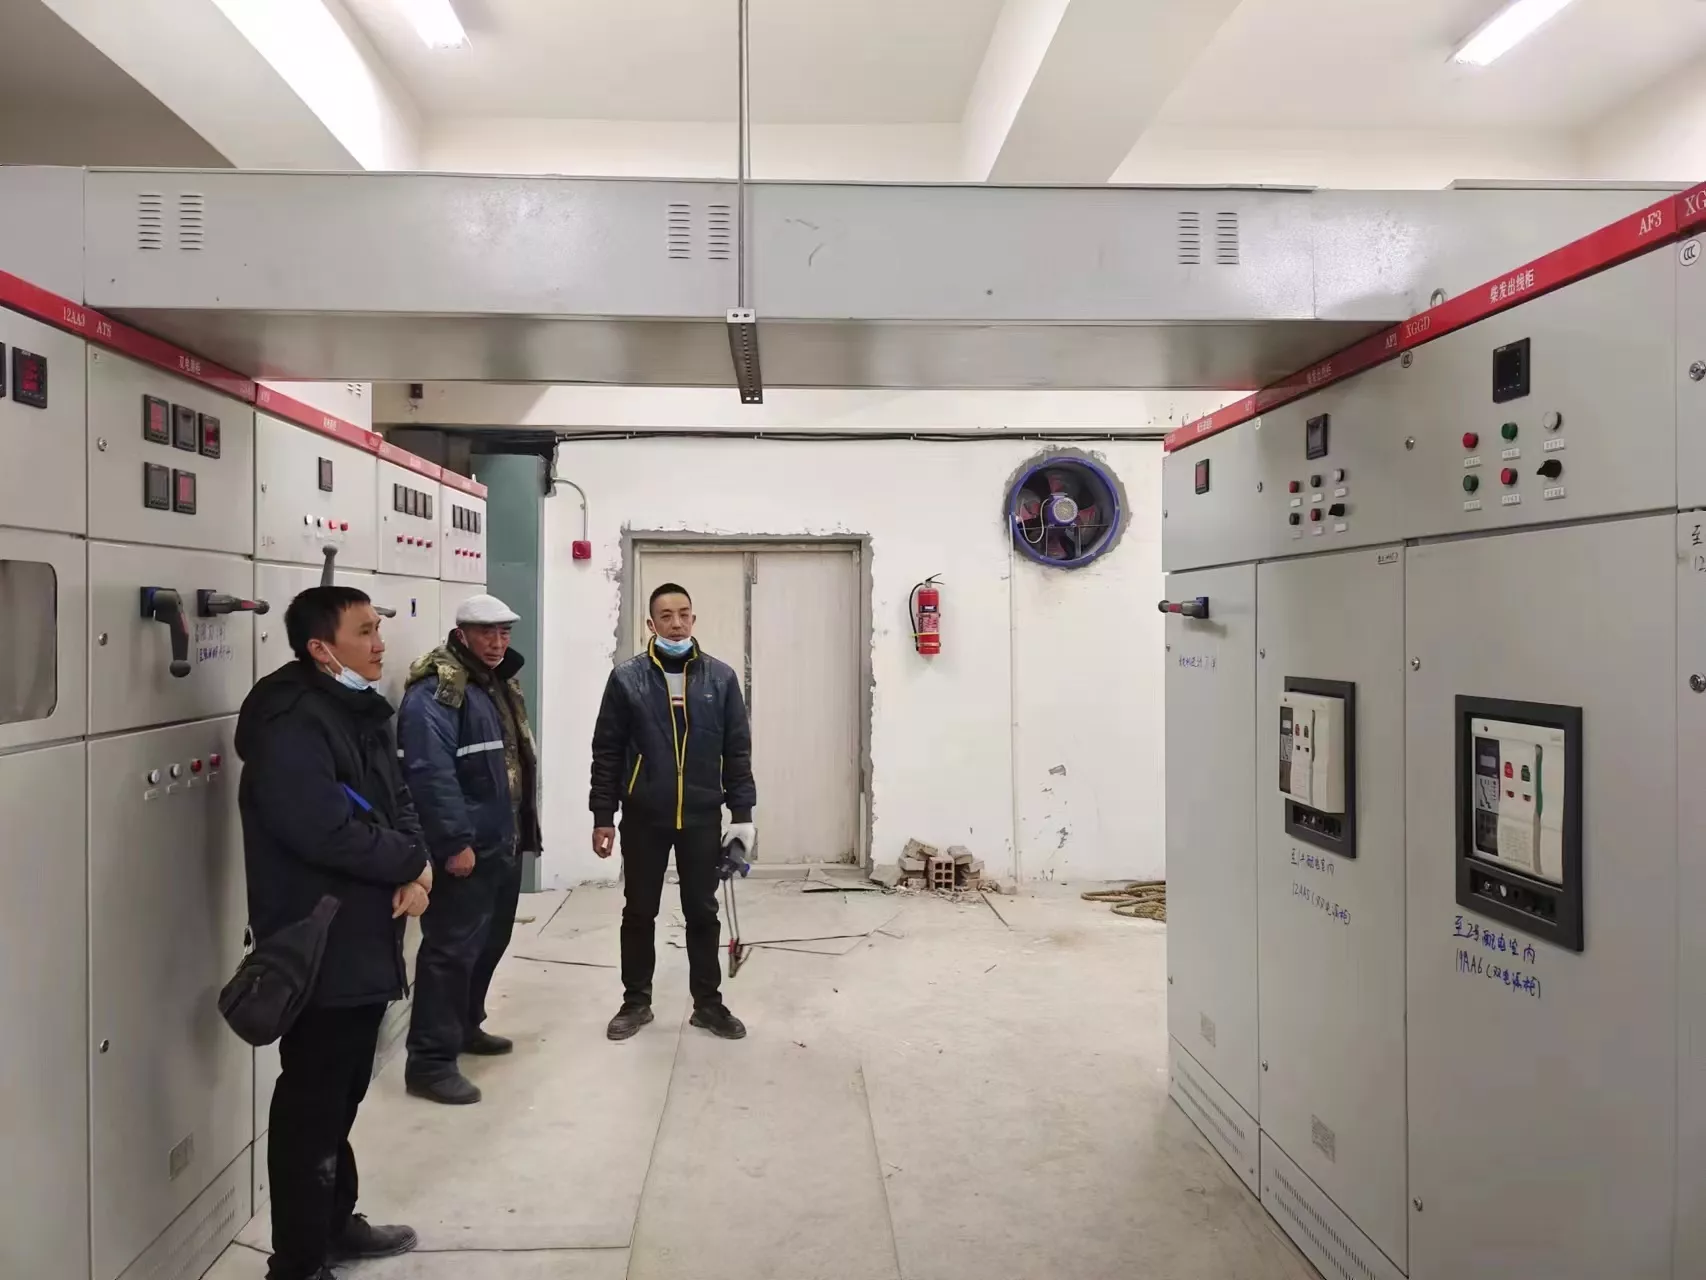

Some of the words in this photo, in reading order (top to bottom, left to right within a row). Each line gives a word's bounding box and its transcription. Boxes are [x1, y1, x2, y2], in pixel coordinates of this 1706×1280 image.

[1638, 210, 1662, 235] AF3
[1490, 269, 1534, 304] 柴发出线柜
[1405, 316, 1431, 338] XGGD
